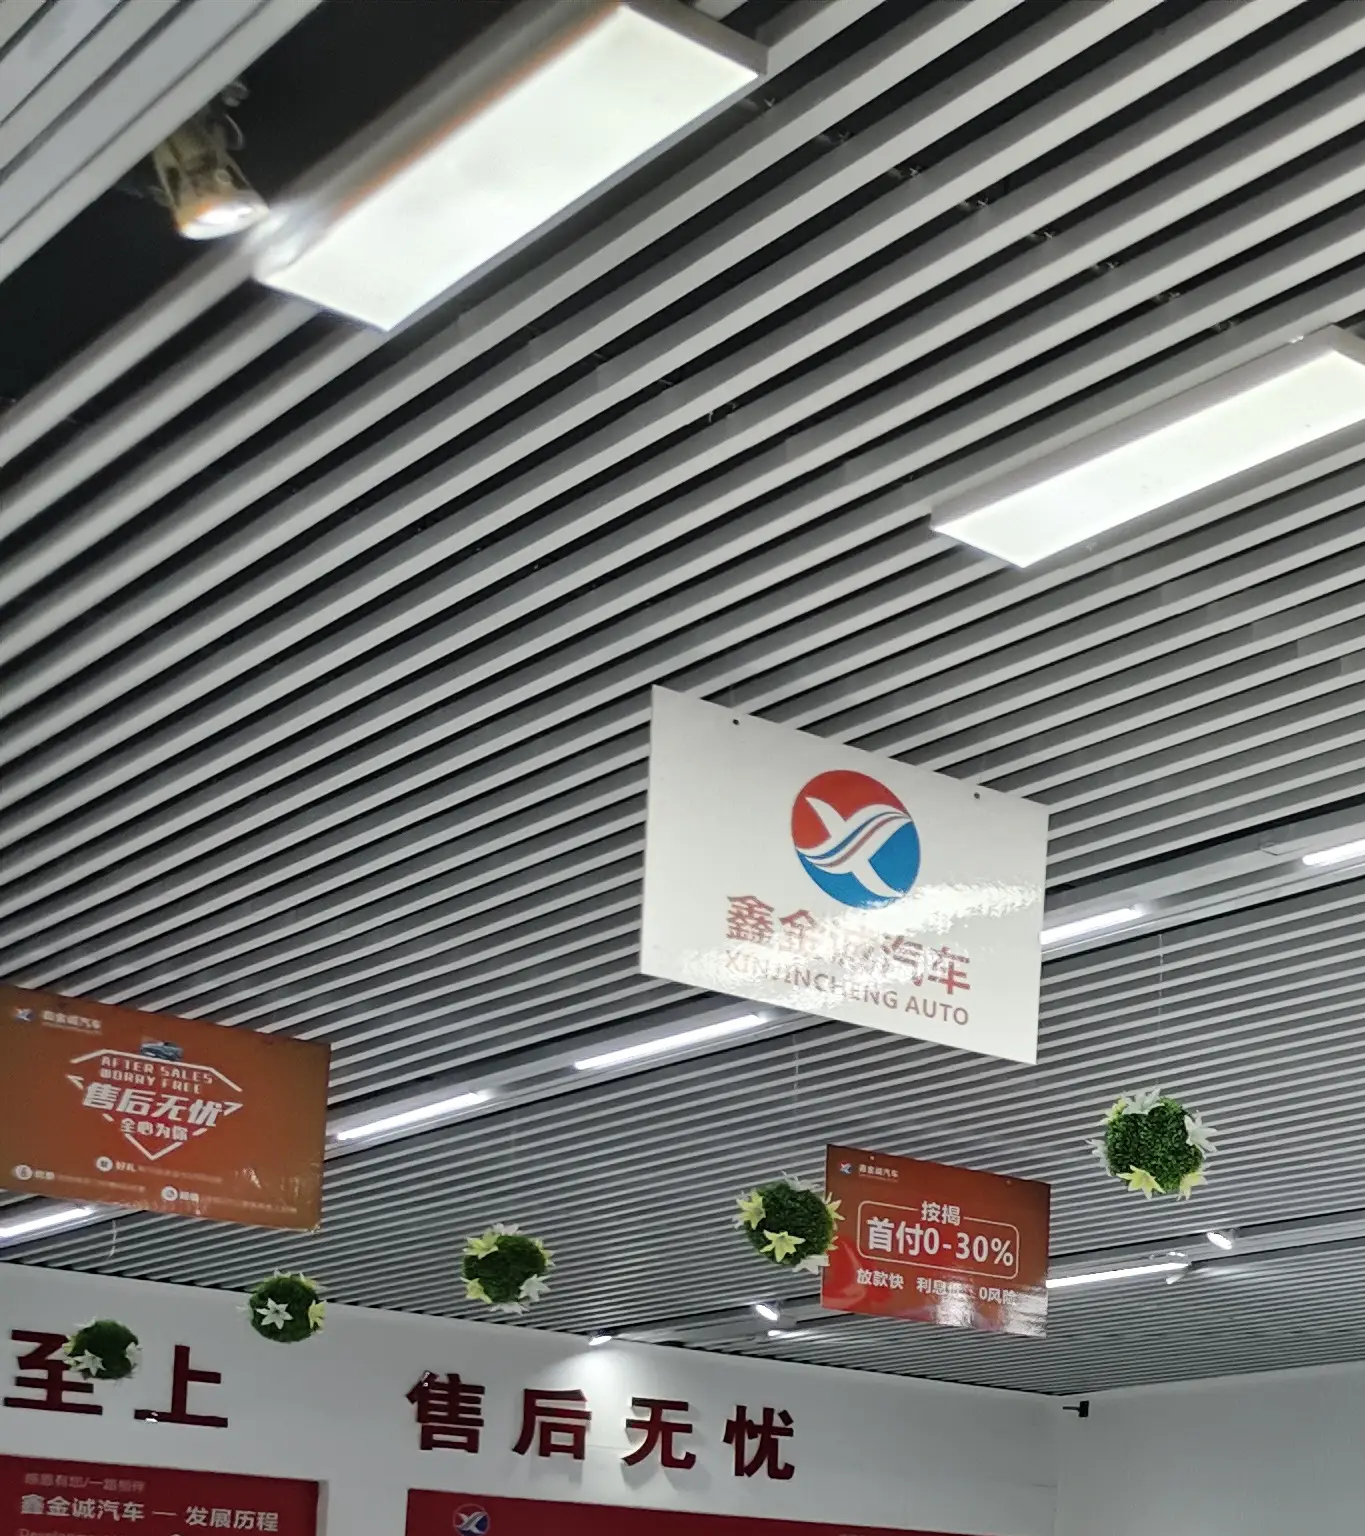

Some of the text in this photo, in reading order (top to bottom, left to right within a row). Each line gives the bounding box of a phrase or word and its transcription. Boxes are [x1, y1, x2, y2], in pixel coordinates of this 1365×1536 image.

[727, 895, 972, 996] 鑫金汽车
[904, 995, 969, 1026] AUTO
[100, 1056, 213, 1085] AFTER SALES
[100, 1069, 201, 1094] WORRY FREE
[82, 1081, 222, 1127] 售后无忧
[921, 1201, 961, 1225] 按揭
[866, 1217, 1014, 1267] 首付0-30%
[856, 1267, 905, 1290] 放款快
[406, 1372, 795, 1480] 售后无忧
[20, 1494, 145, 1522] 鑫金诚汽车
[185, 1505, 279, 1533] 发展历程
